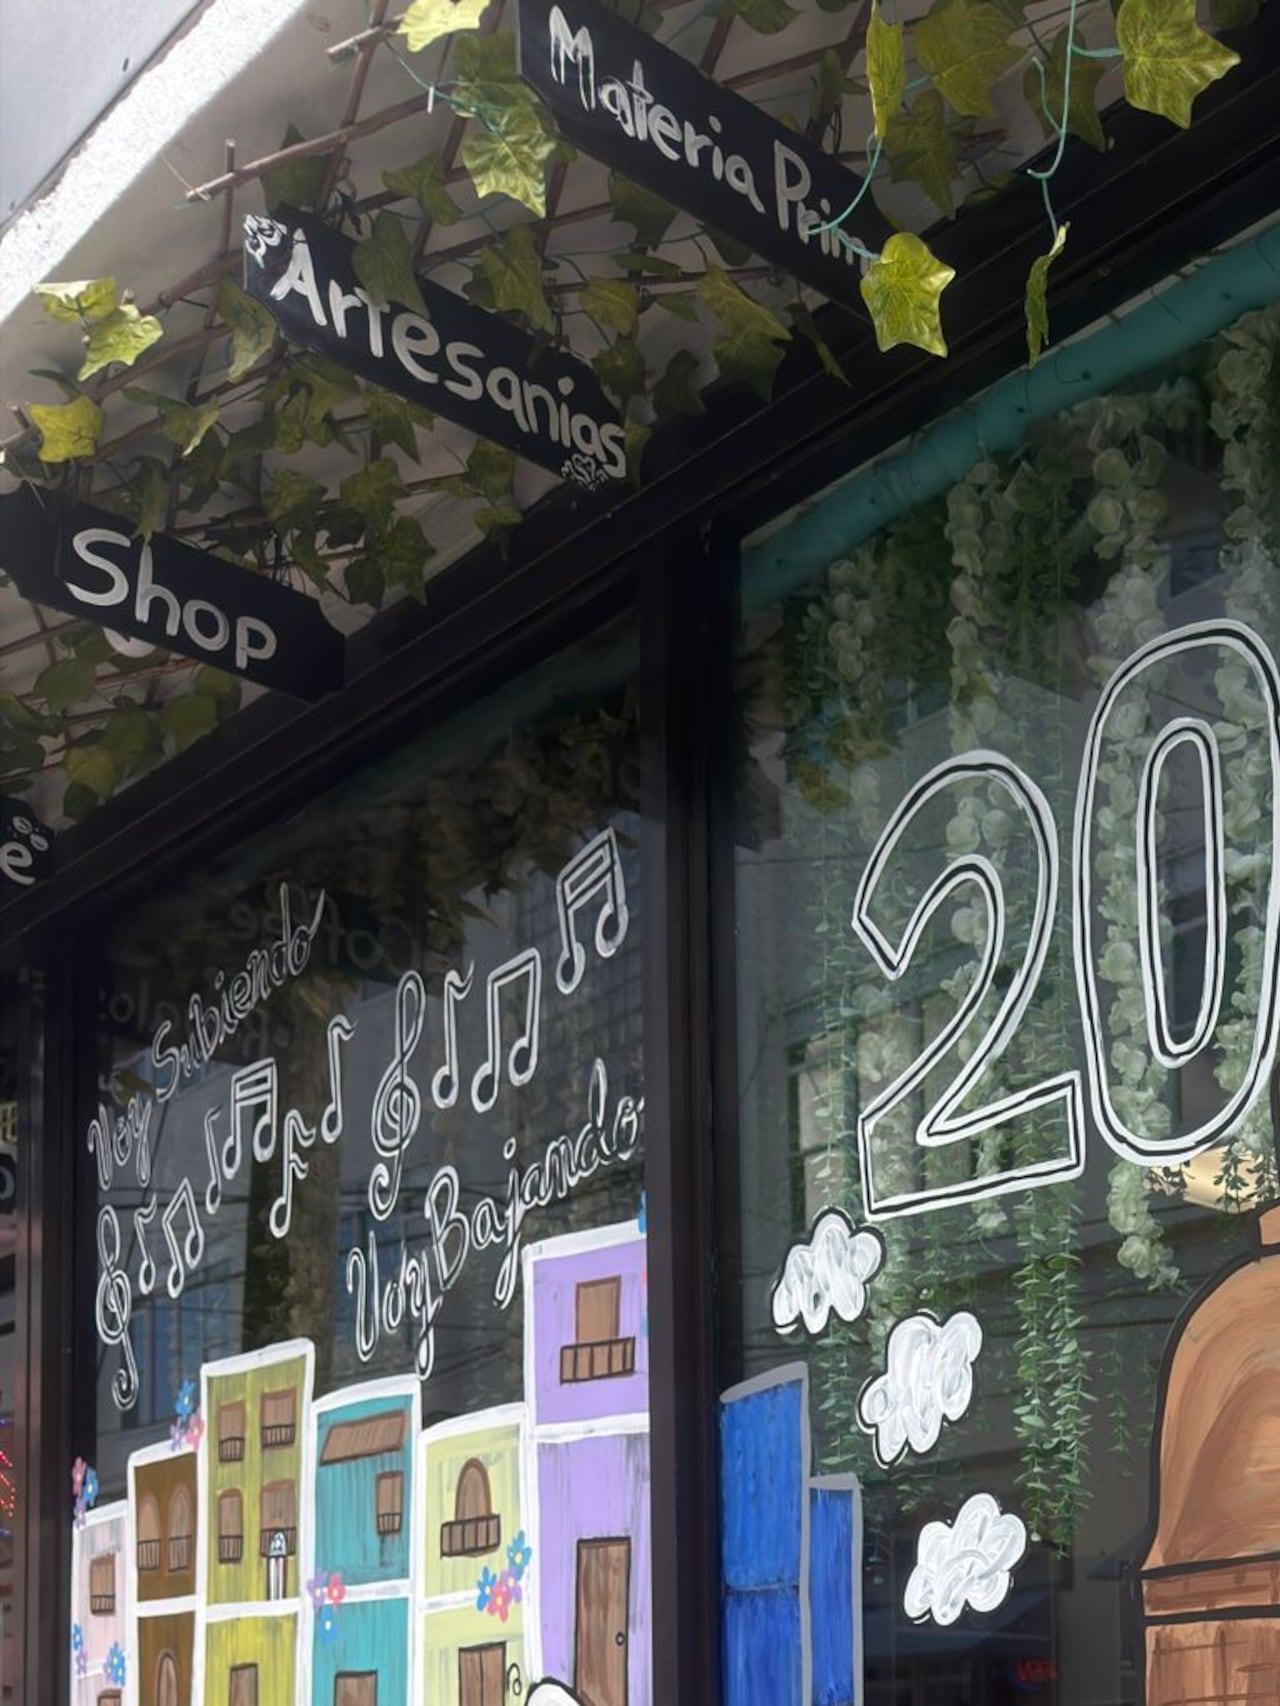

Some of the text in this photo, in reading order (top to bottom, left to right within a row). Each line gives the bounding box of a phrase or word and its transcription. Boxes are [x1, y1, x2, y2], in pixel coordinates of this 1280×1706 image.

[548, 4, 872, 279] Materia Prim
[269, 228, 628, 479] Artesanias
[65, 527, 278, 670] Shop
[87, 1095, 152, 1192] Voy
[152, 881, 326, 1103] Subiendo
[346, 1230, 444, 1381] Voy
